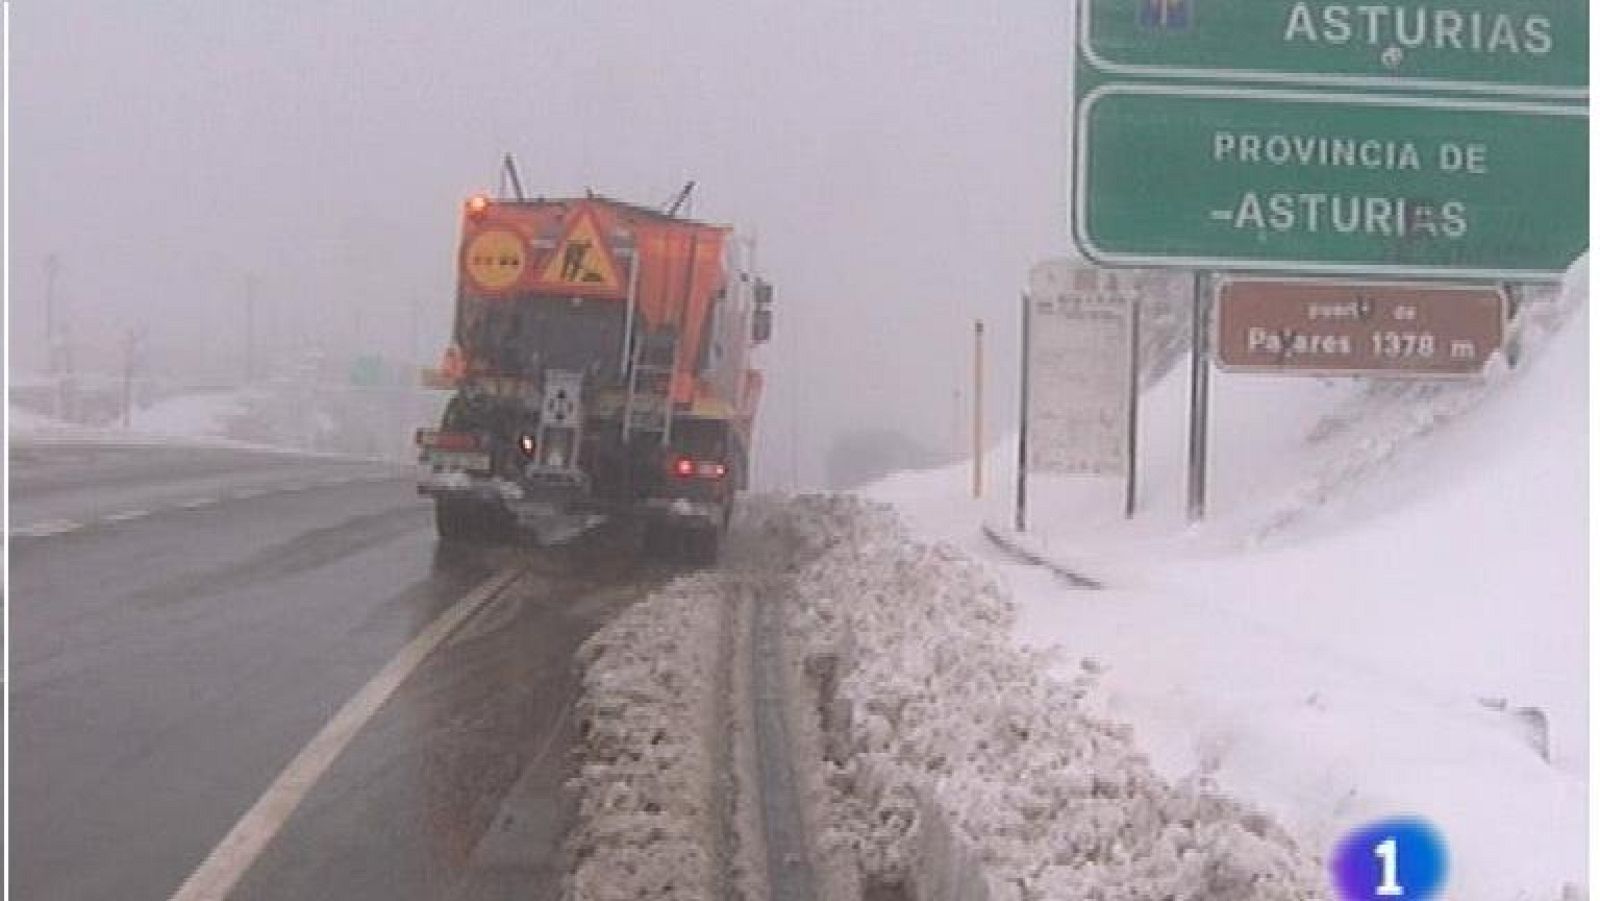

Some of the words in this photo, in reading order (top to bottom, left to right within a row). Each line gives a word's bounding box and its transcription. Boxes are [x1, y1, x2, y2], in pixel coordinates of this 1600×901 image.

[1283, 1, 1554, 55] ASTURIAS
[1213, 132, 1421, 171] PROVINCIA
[1439, 144, 1488, 174] DE
[1372, 331, 1435, 358] 1378
[1450, 340, 1476, 359] m
